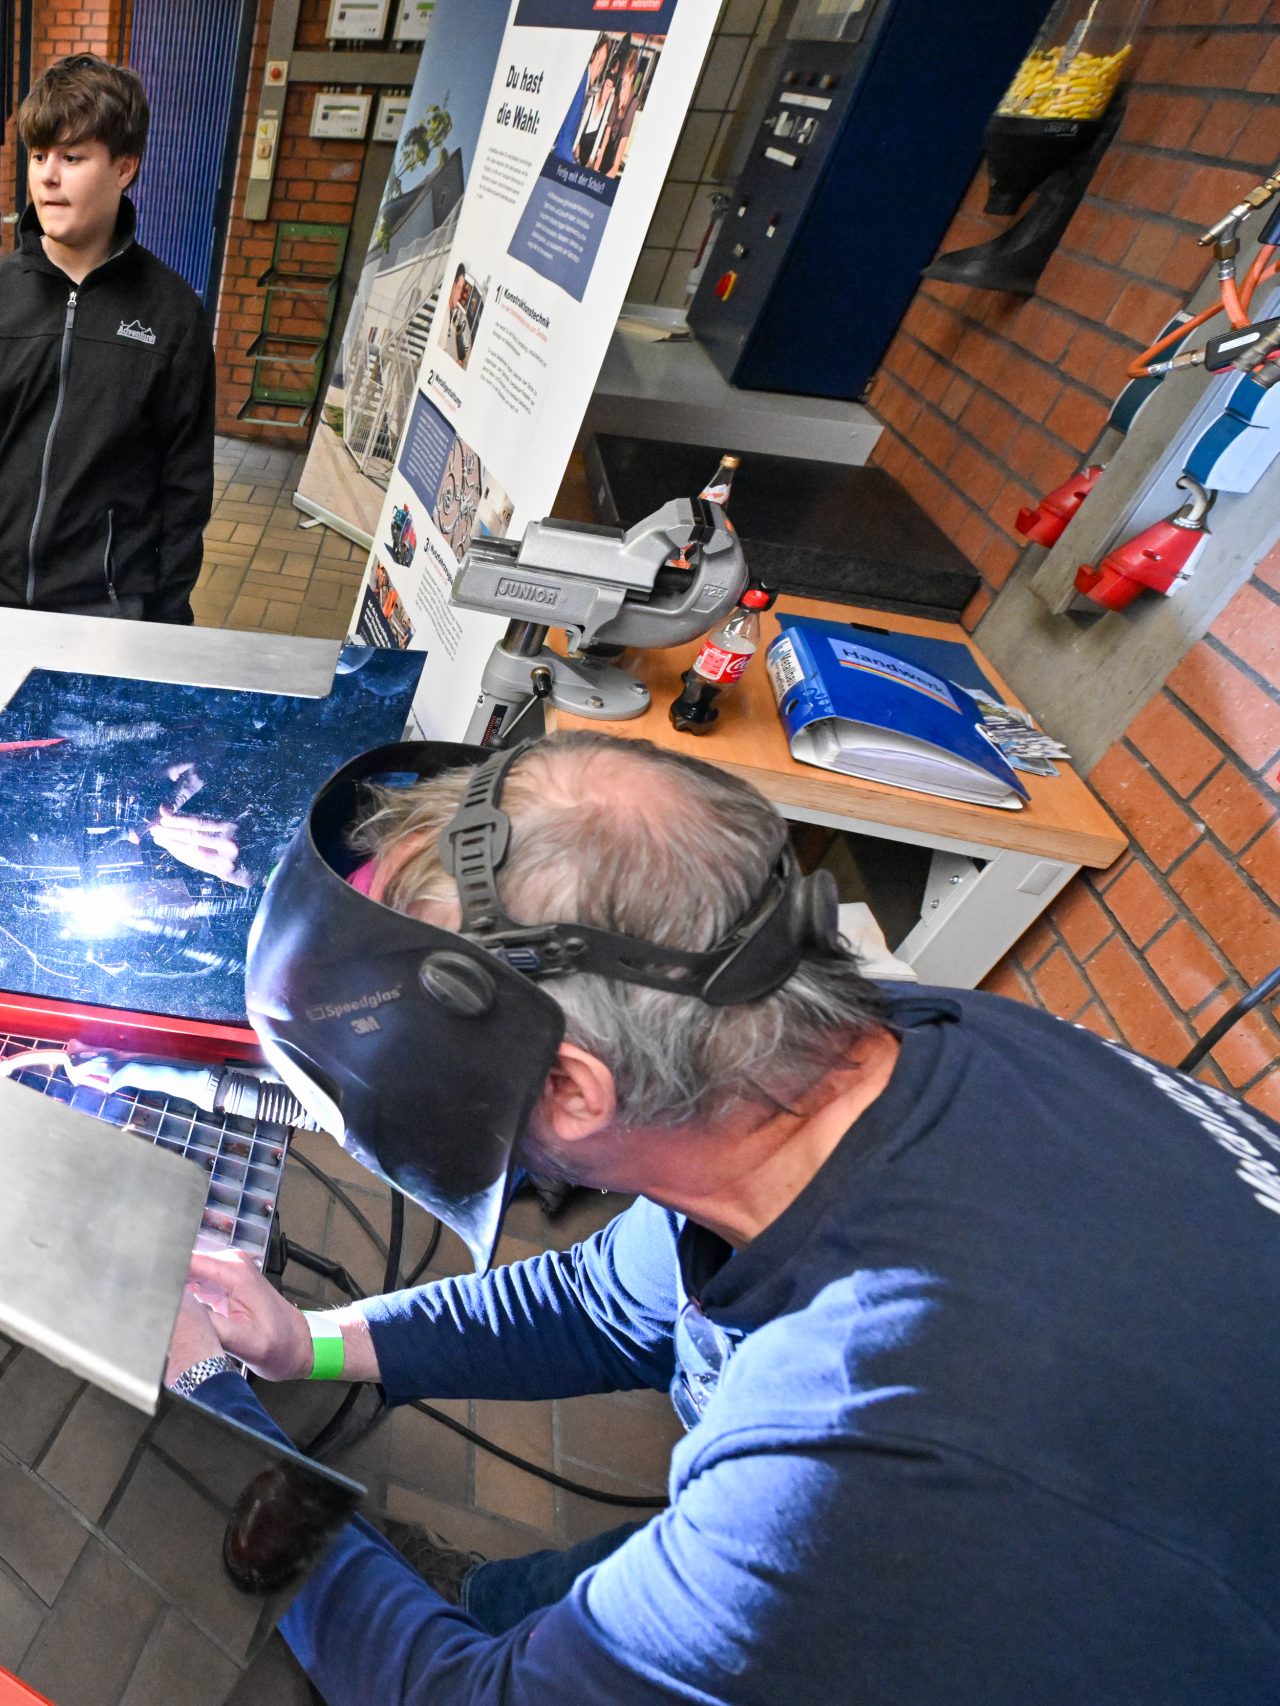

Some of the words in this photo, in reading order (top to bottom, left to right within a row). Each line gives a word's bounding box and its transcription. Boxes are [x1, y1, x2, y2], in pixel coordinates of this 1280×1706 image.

[505, 65, 518, 88] Du
[519, 67, 544, 94] hast
[496, 102, 510, 126] die
[512, 105, 541, 135] Wahl:
[499, 579, 559, 606] JUNIOR
[703, 584, 726, 598] 125
[842, 648, 947, 695] Handwerk
[325, 989, 401, 1018] Speedglas
[350, 1015, 381, 1034] 3M
